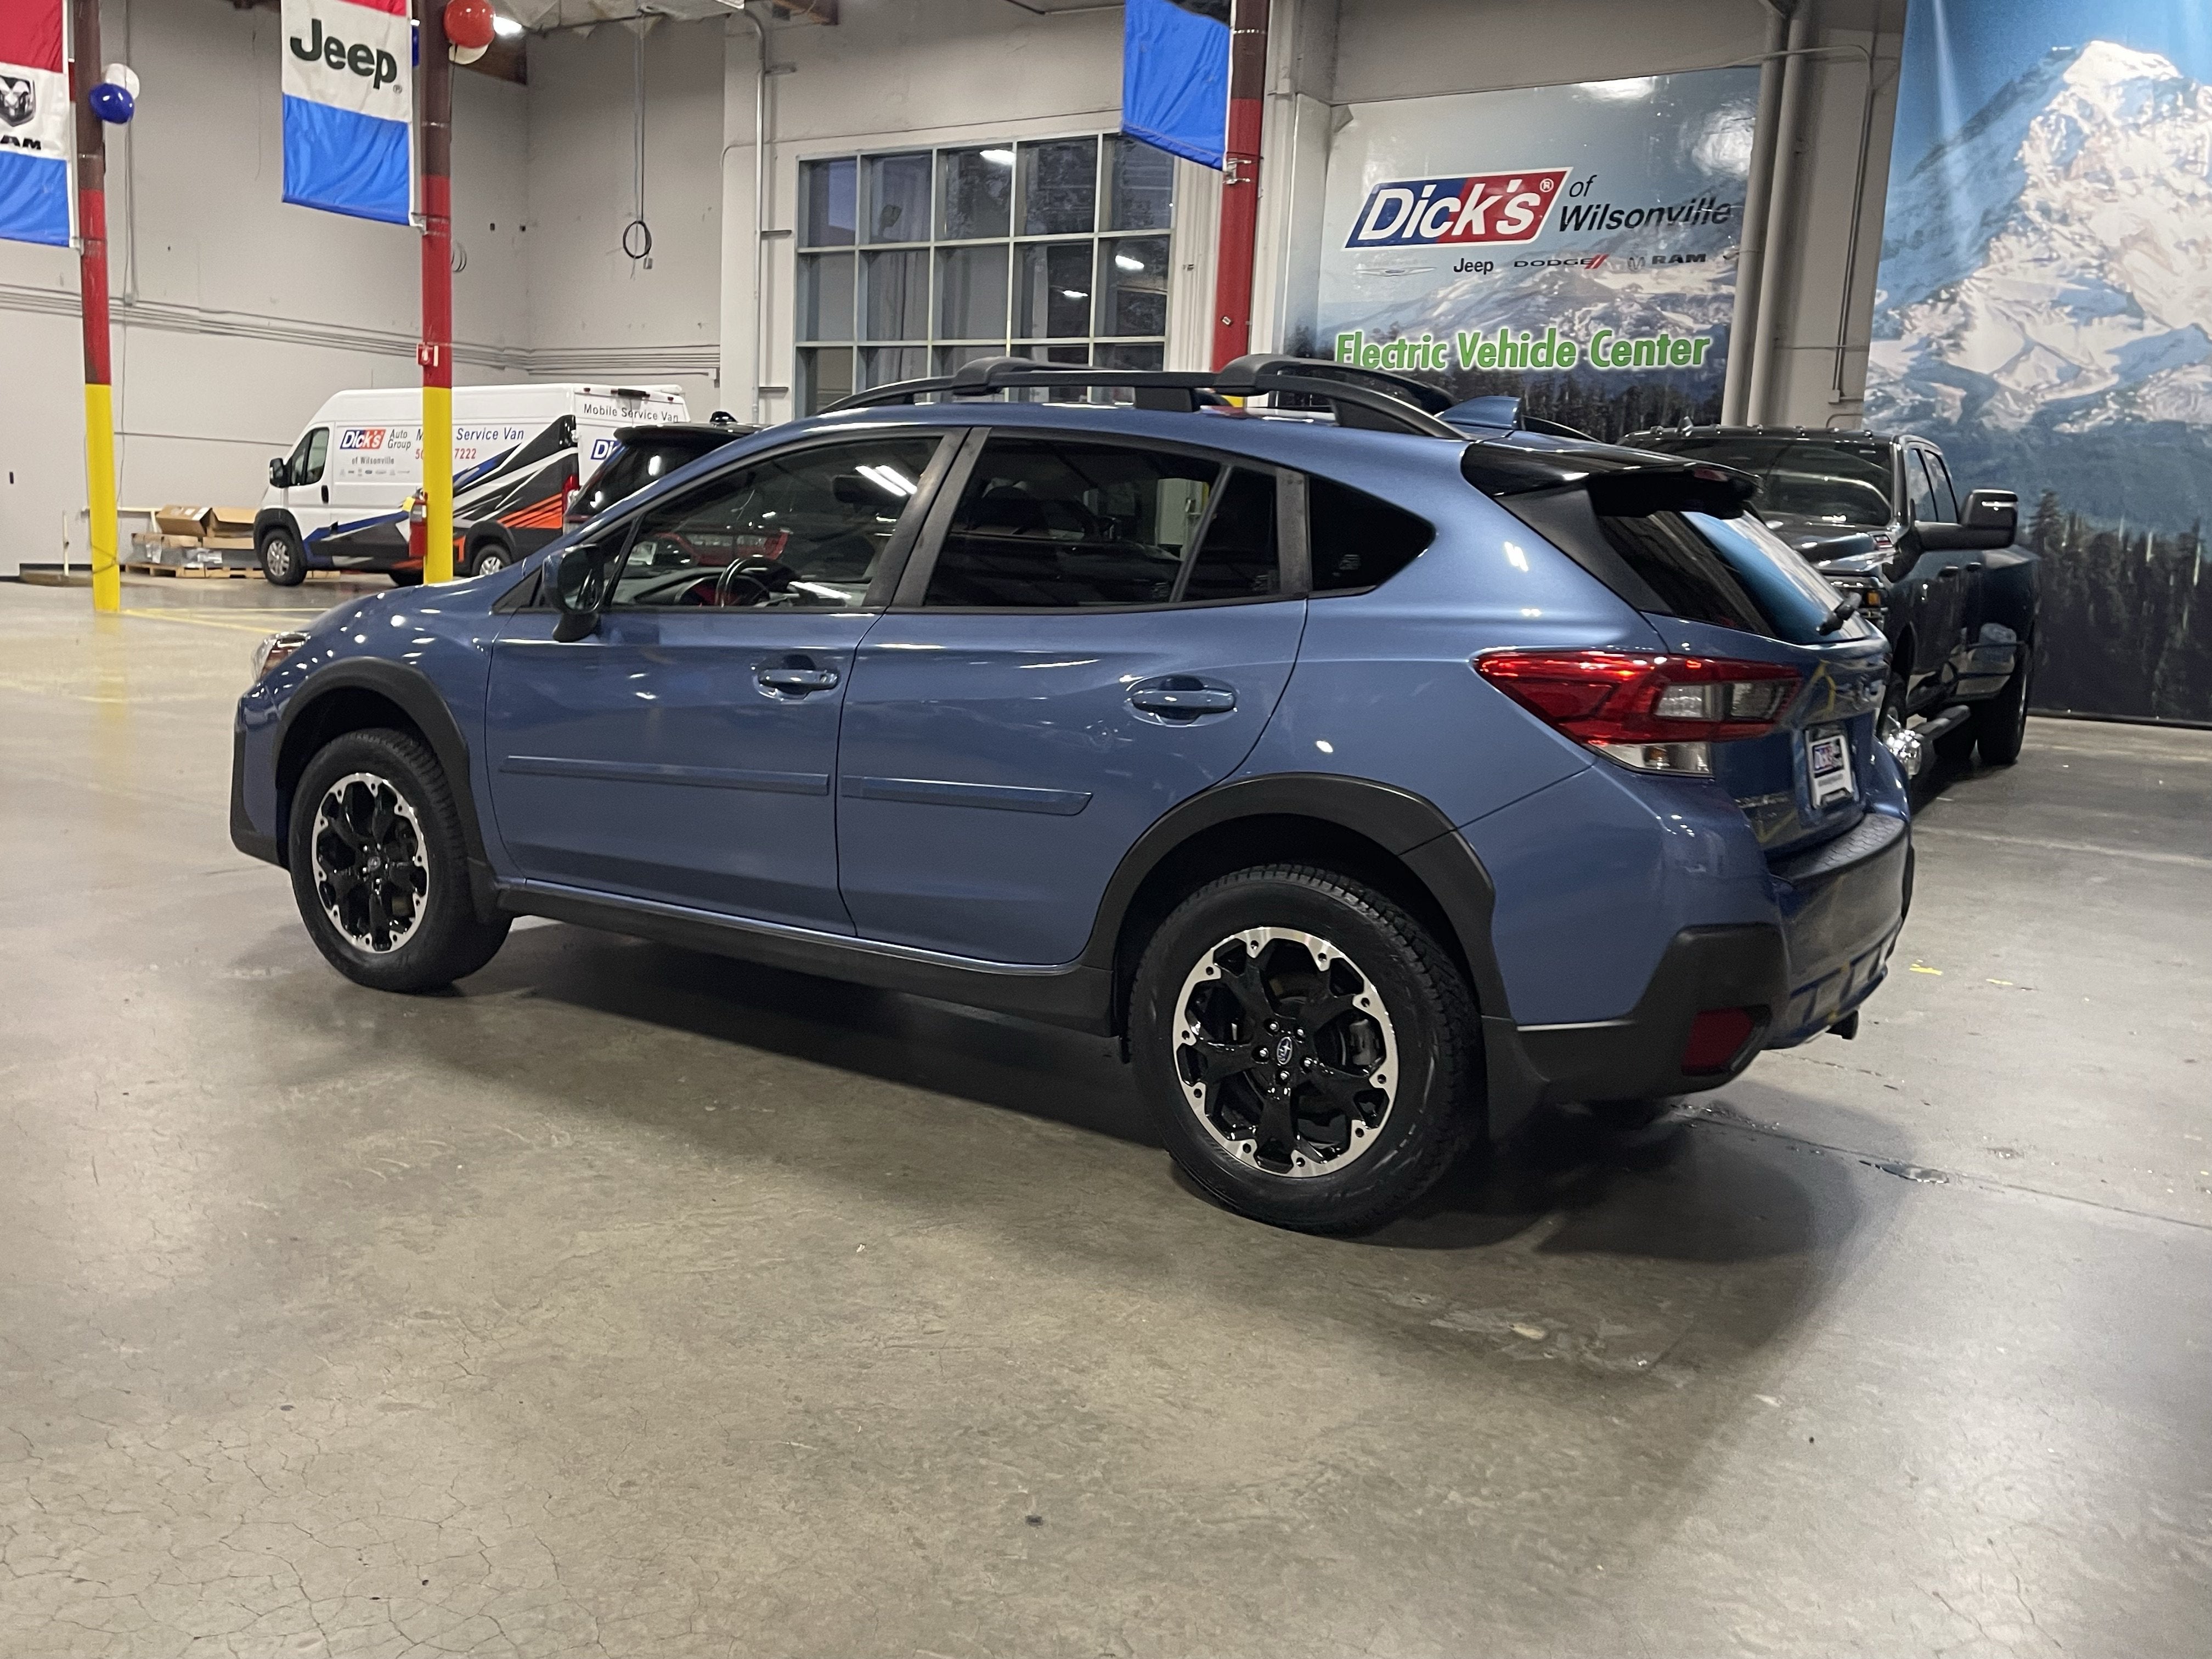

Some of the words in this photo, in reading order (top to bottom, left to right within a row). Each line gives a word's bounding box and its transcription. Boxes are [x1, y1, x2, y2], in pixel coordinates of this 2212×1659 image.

[290, 18, 397, 90] Jeep
[0, 135, 41, 150] AM
[1357, 179, 1541, 240] Dick's
[1568, 174, 1597, 198] of
[1559, 196, 1731, 232] Wilsonville
[1453, 257, 1494, 275] Jeep
[1514, 258, 1593, 268] DODGE
[1651, 253, 1706, 265] RAM
[1336, 331, 1447, 369] Electric
[1458, 328, 1576, 368] Vehicle
[1591, 329, 1711, 367] Center
[583, 403, 618, 416] Mobile
[622, 407, 658, 420] Service
[661, 411, 679, 422] Van
[341, 430, 382, 448] Dick's
[390, 429, 408, 439] Auto
[456, 427, 498, 440] Service
[504, 427, 524, 439] Van
[387, 439, 411, 451] Group
[360, 456, 394, 465] Wilsonville
